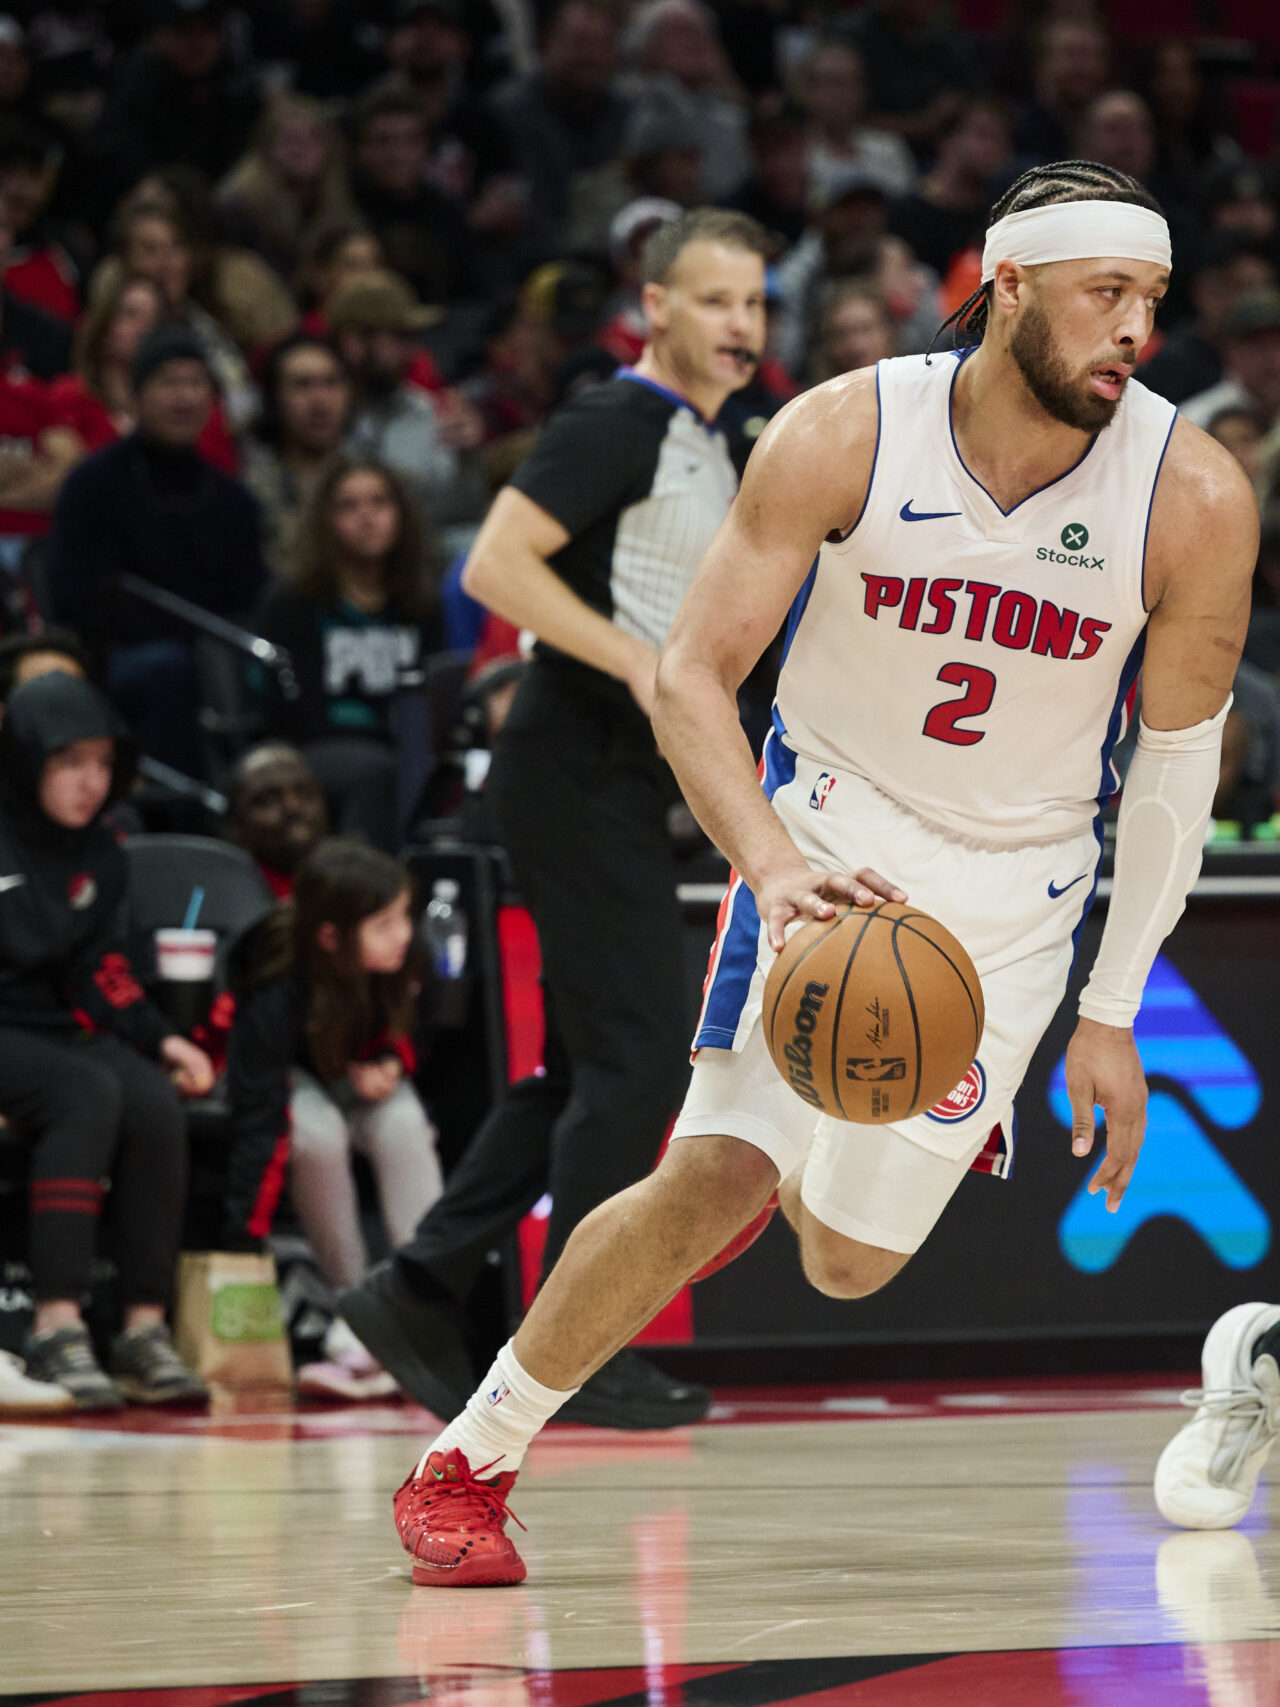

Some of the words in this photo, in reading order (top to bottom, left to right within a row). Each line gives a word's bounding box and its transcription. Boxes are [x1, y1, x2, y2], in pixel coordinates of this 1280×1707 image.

[1036, 547, 1105, 571] StockX
[860, 572, 1112, 660] PISTONS
[922, 661, 997, 746] 2
[784, 980, 830, 1109] Wilson
